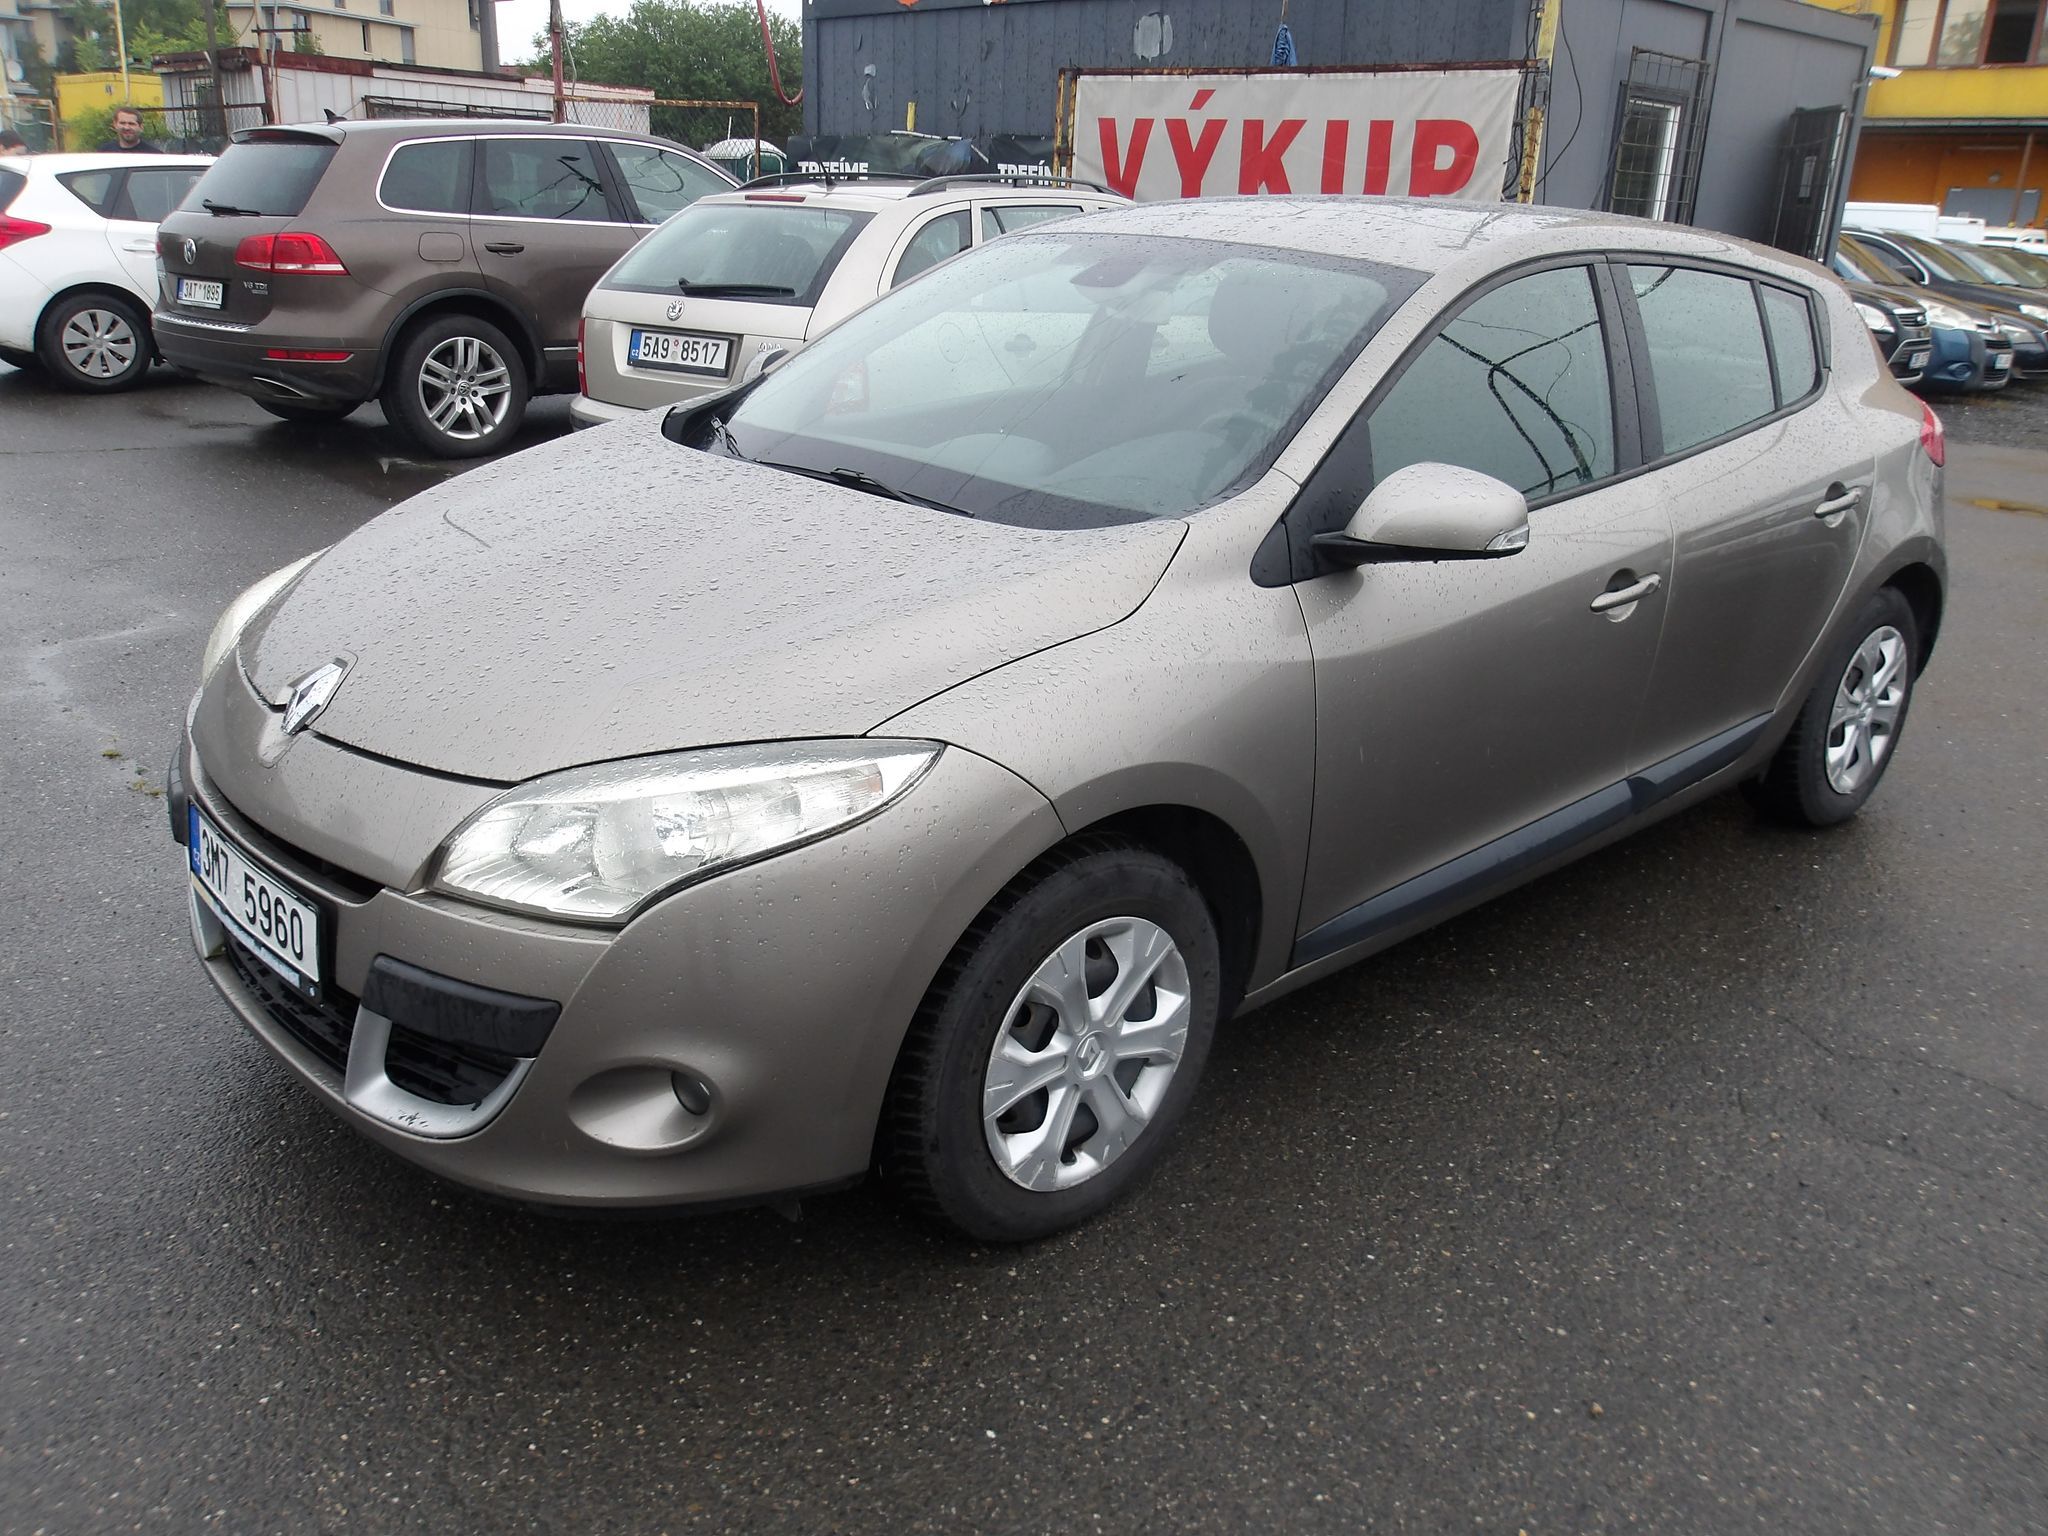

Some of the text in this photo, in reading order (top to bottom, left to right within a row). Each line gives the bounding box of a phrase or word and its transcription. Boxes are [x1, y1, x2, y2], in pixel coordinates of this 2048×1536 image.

[1098, 89, 1479, 199] VÝKUP
[184, 279, 197, 299] 3AT
[642, 335, 720, 365] 5A9 8517
[202, 828, 304, 961] 3M7 5960
